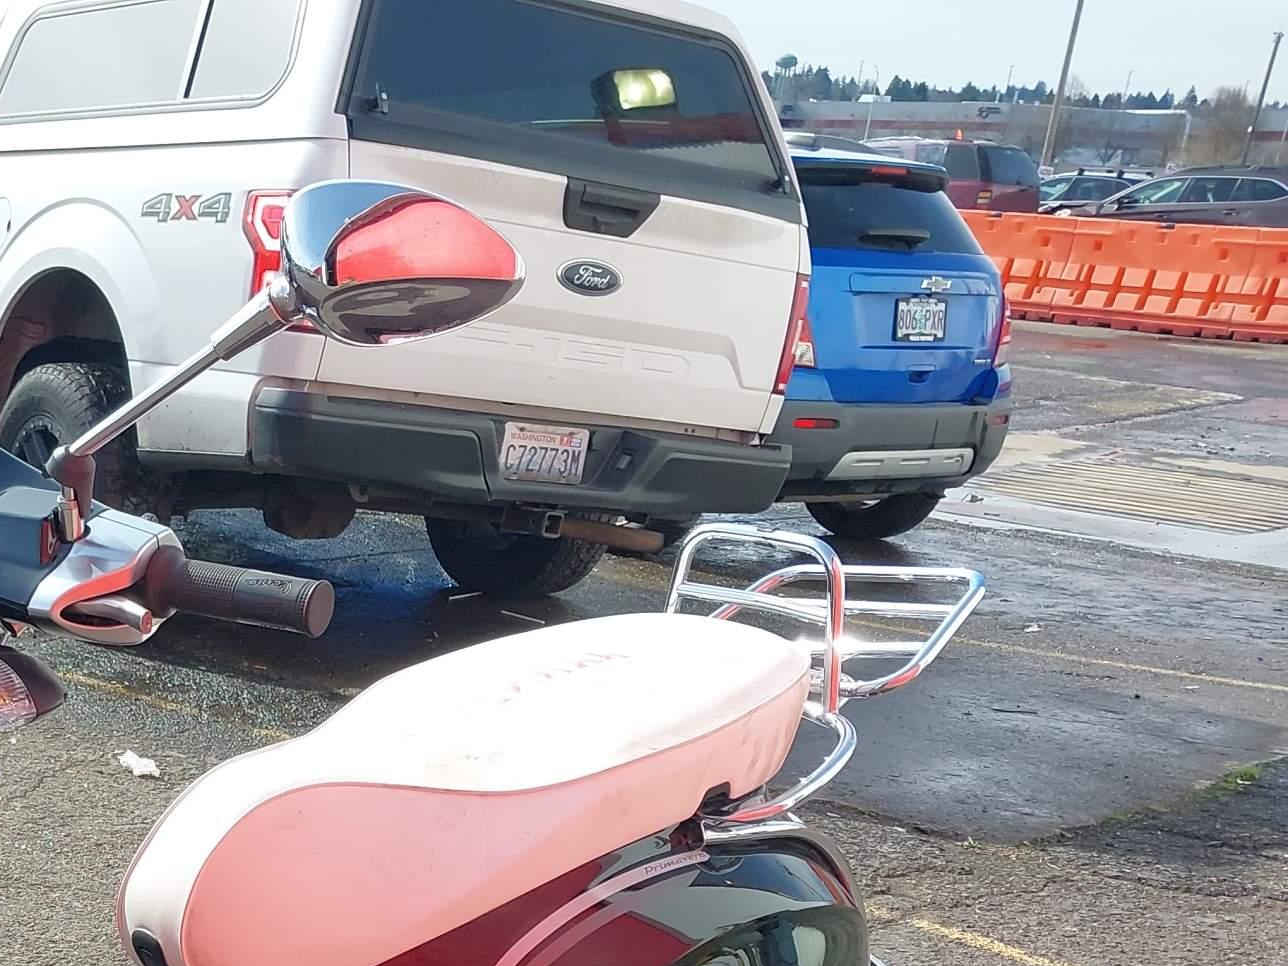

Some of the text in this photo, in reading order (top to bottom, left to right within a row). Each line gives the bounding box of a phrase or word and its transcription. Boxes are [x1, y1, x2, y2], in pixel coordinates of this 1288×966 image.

[573, 265, 611, 289] Ford
[897, 309, 945, 331] 806 PXR
[512, 432, 557, 444] WASHINGTON
[504, 444, 582, 477] C72773M
